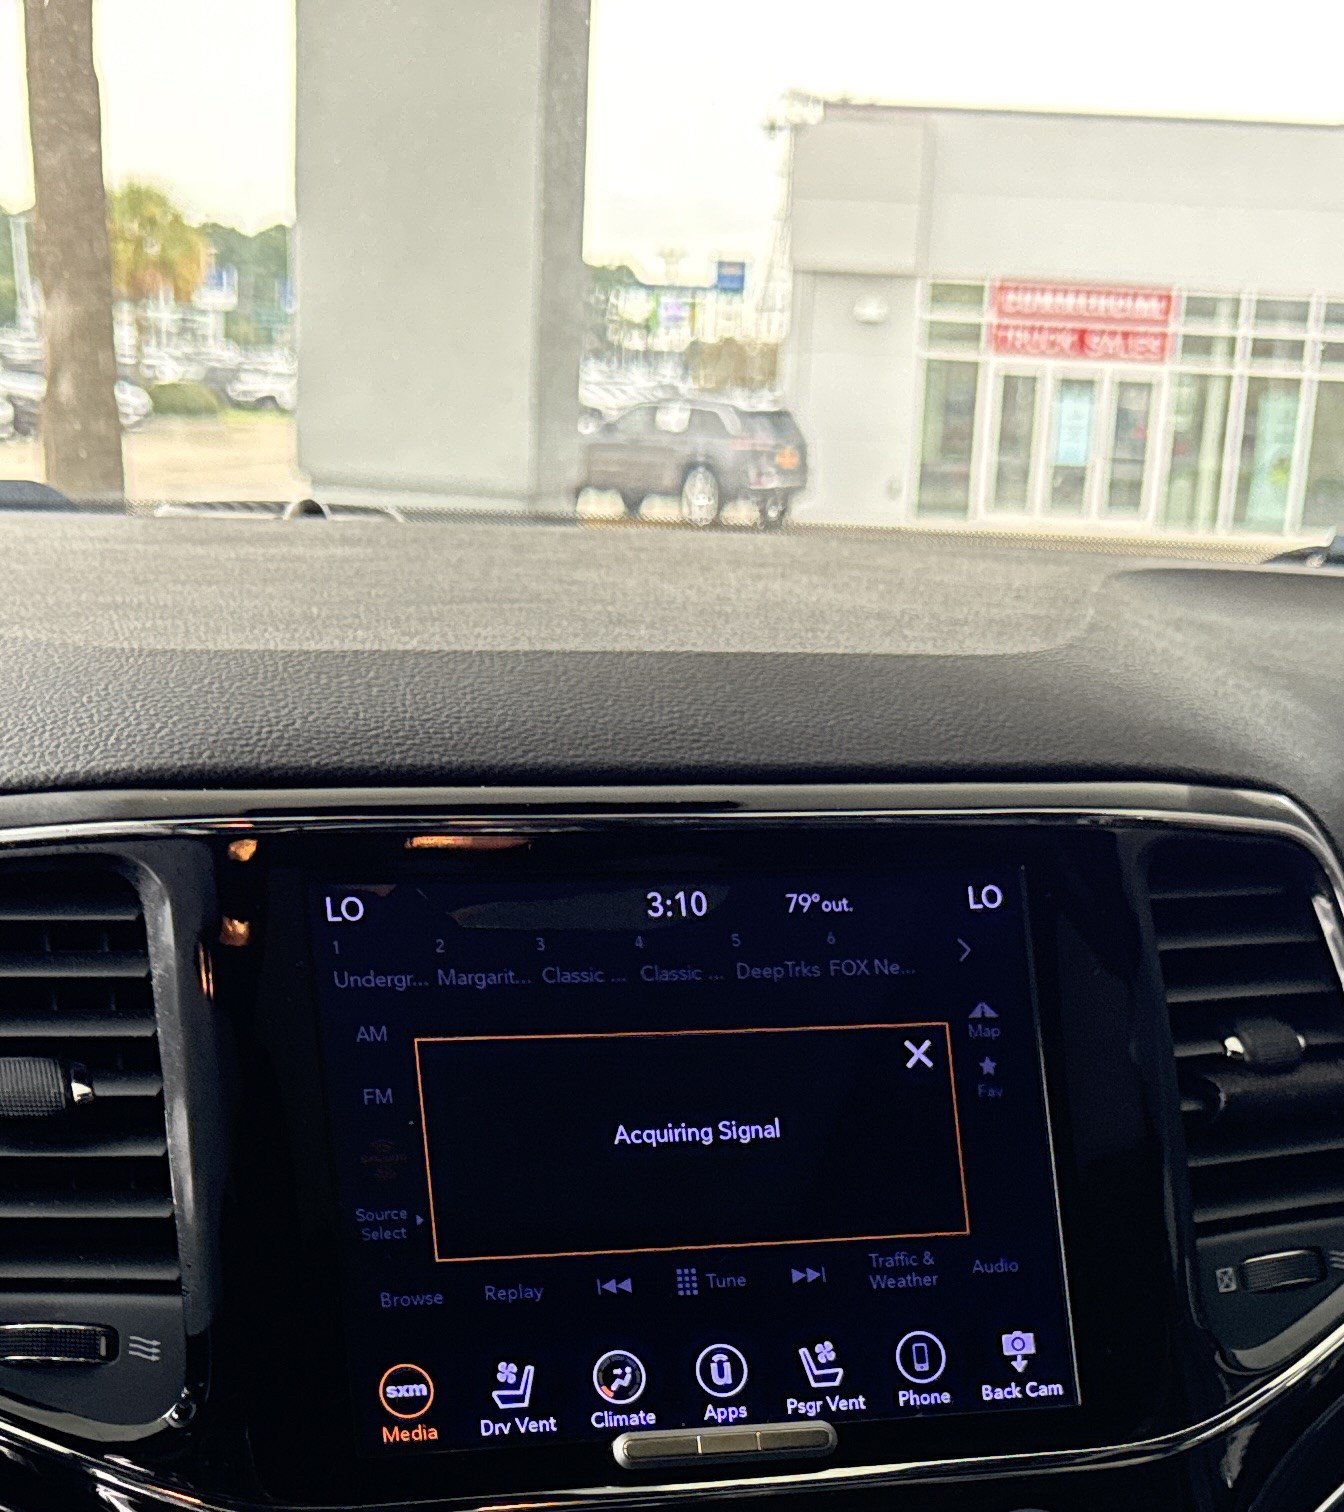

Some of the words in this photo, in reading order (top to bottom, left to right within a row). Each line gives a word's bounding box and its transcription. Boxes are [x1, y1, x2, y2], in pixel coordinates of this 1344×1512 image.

[646, 890, 708, 917] 3:10
[967, 884, 1003, 910] LO
[325, 897, 364, 922] LO
[436, 939, 445, 953] 2
[536, 937, 546, 951] 3
[635, 935, 644, 949] 4
[731, 933, 741, 947] 5
[827, 931, 836, 945] 6
[332, 941, 340, 954] 1
[736, 961, 820, 982] DeepTrks
[830, 959, 869, 976] FOX
[356, 1026, 388, 1042] AM
[968, 1023, 1001, 1041] Map
[363, 1089, 393, 1105] FM
[614, 1122, 713, 1147] Acquiring
[718, 1118, 781, 1143] Signal
[356, 1208, 407, 1222] Source
[361, 1227, 407, 1241] Select
[868, 1252, 919, 1269] Traffic
[922, 1251, 935, 1266] &
[972, 1258, 1019, 1274] Audio
[706, 1273, 747, 1289] Tune
[869, 1272, 938, 1289] Weather
[380, 1291, 444, 1308] Browse
[485, 1284, 544, 1304] Replay
[386, 1383, 428, 1398] sxm
[898, 1389, 951, 1406] Phone
[982, 1383, 1022, 1401] Back
[1026, 1381, 1064, 1398] Cam
[704, 1404, 748, 1422] Apps
[787, 1398, 821, 1417] Psgr
[826, 1395, 866, 1411] Vent
[481, 1419, 513, 1437] Drv
[515, 1416, 557, 1434] Vent
[591, 1410, 657, 1429] Climate
[382, 1425, 438, 1444] Media
